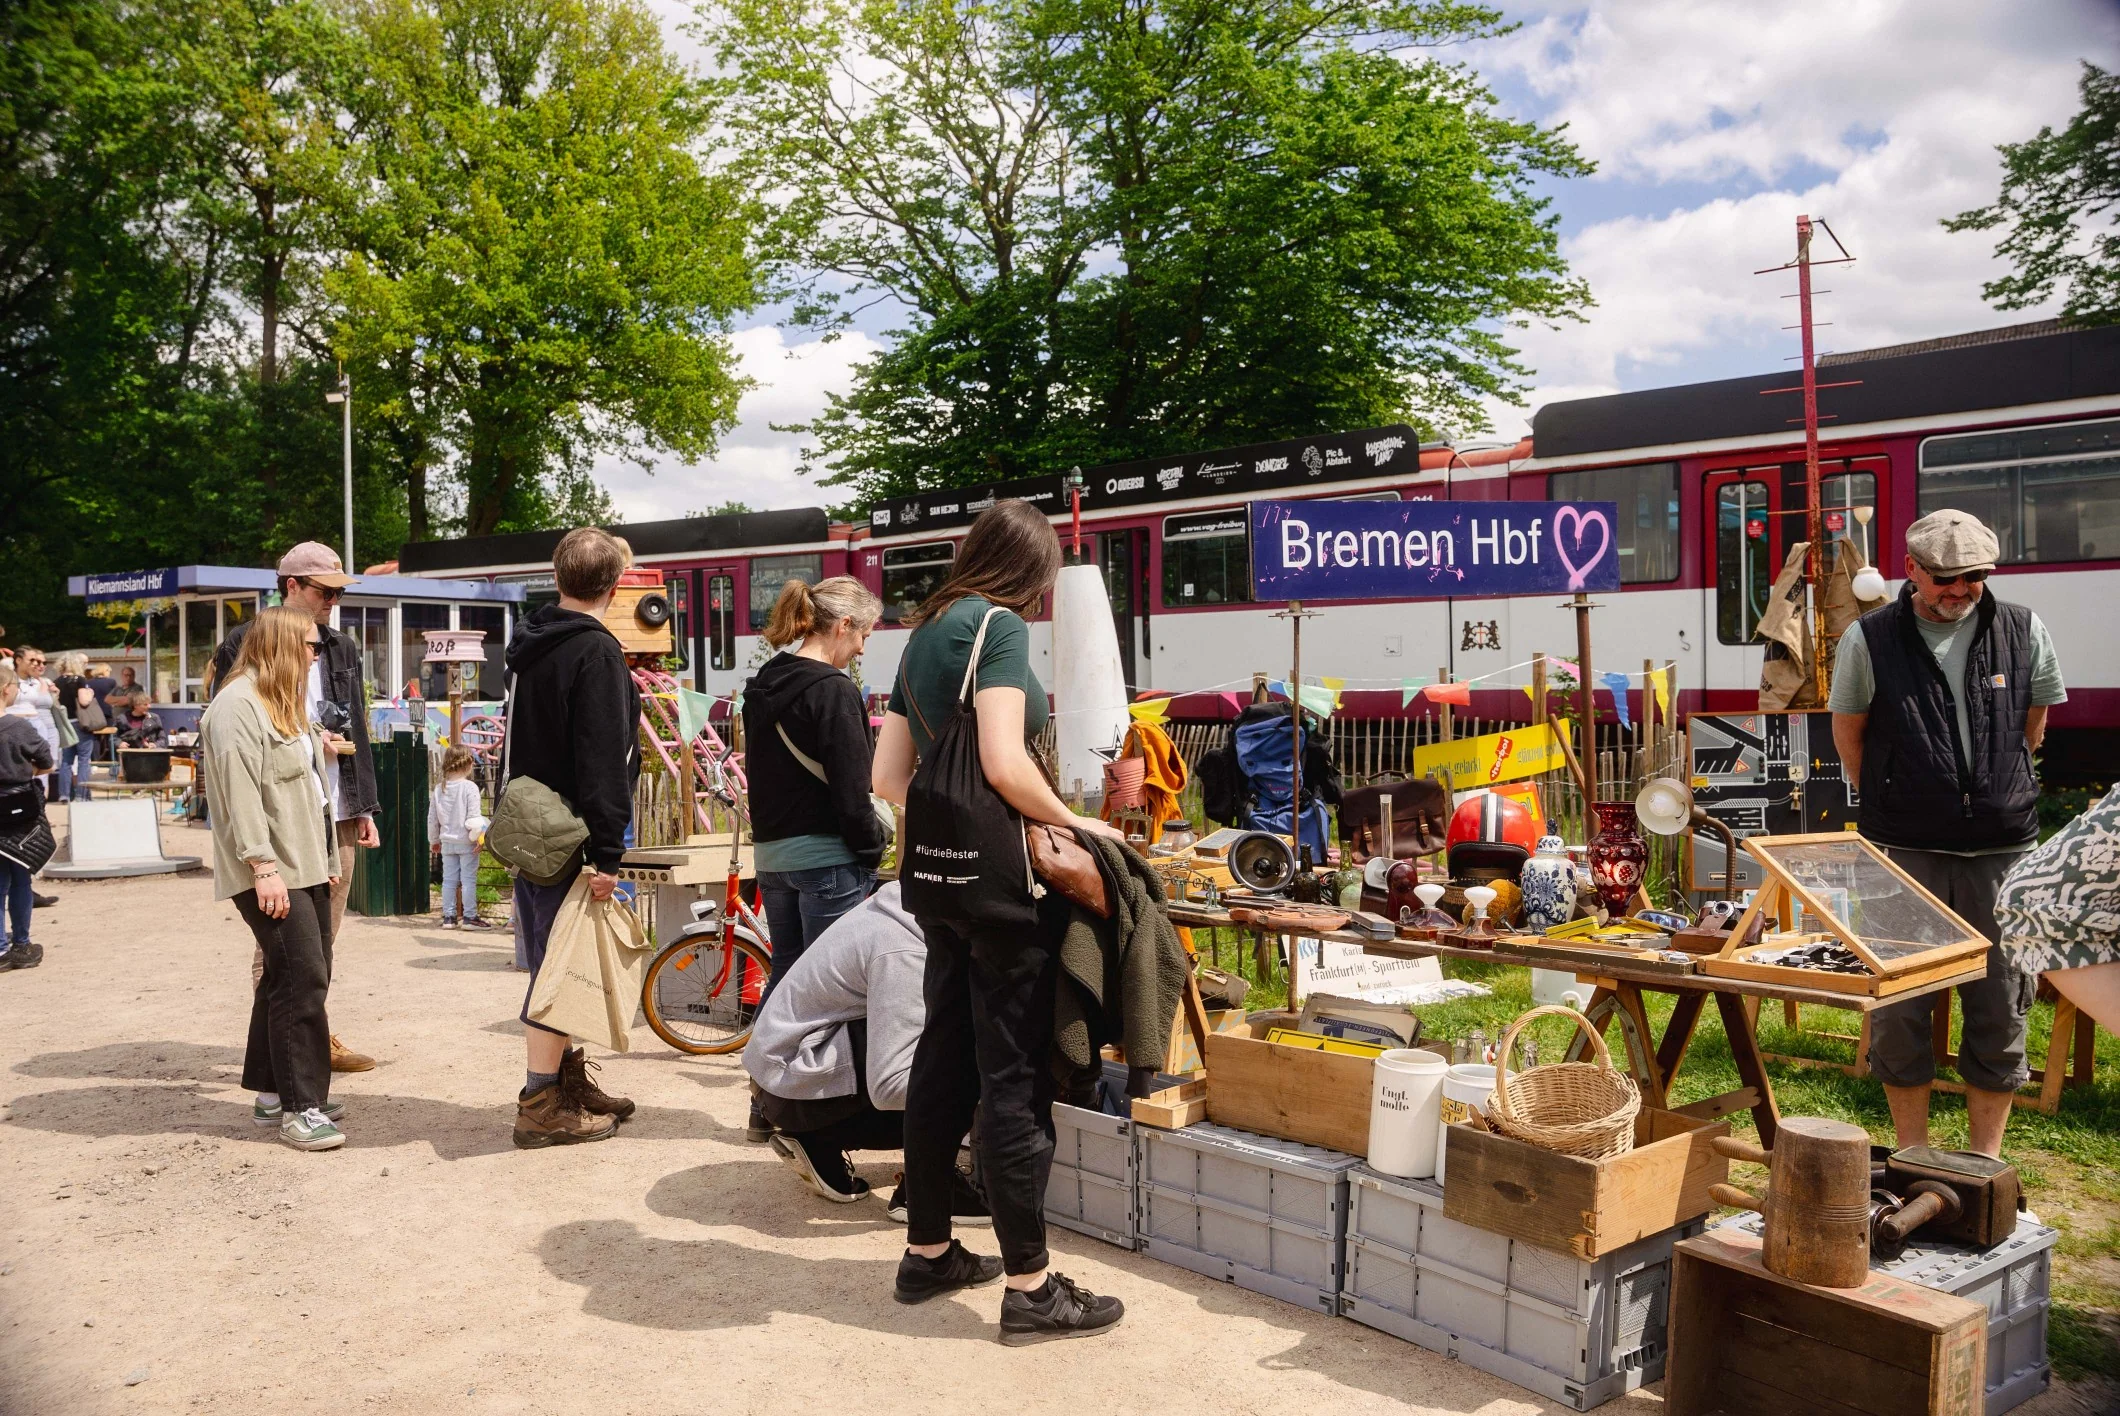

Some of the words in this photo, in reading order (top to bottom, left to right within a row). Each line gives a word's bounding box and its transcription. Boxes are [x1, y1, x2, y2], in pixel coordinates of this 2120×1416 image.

[1326, 456, 1352, 466] Abfahrt
[930, 506, 940, 515] SAN
[1282, 519, 1453, 568] Bremen
[1471, 518, 1542, 565] Hbf
[866, 555, 878, 567] 211
[88, 575, 146, 595] Kliemannsland
[147, 574, 163, 590] Hbf
[1491, 738, 1510, 777] herbol
[915, 844, 979, 859] #fürdieBesten
[1342, 947, 1363, 957] Karls
[1380, 1099, 1410, 1112] molle
